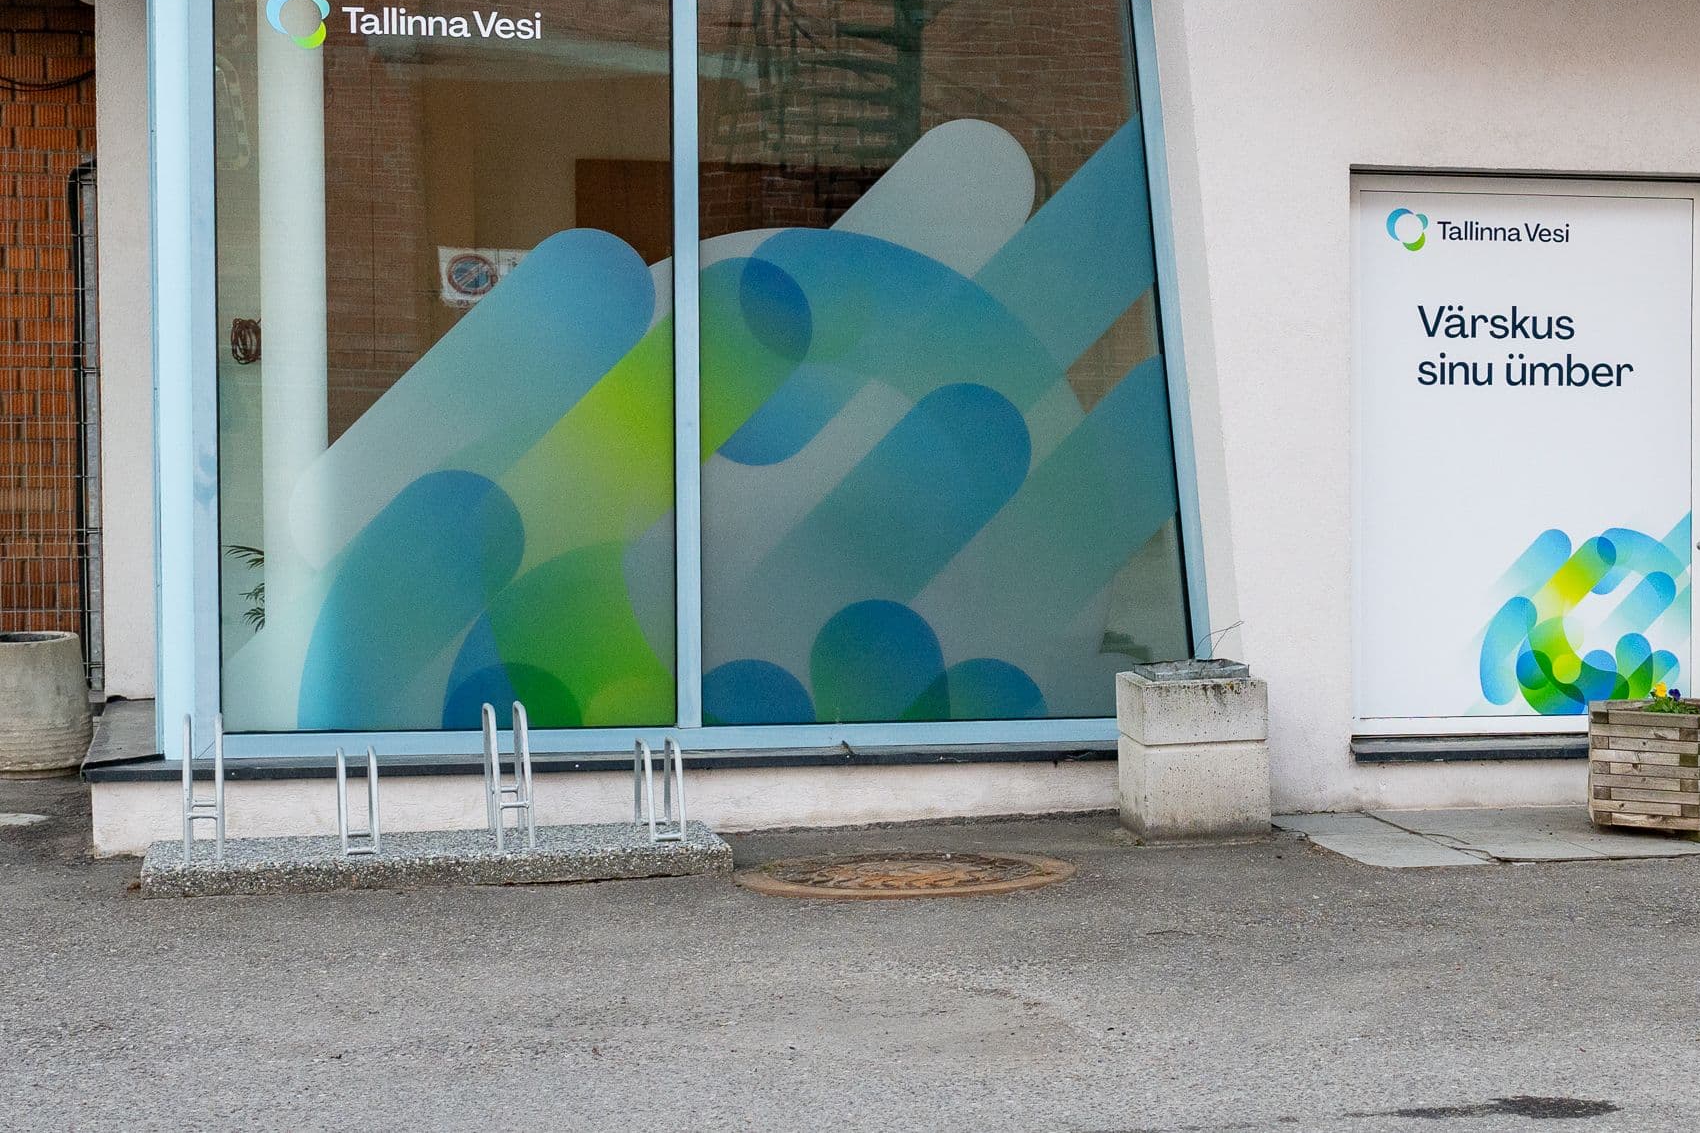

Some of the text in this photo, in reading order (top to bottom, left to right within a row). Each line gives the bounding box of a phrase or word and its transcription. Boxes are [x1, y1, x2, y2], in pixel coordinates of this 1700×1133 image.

[341, 6, 542, 40] Tallinna Vesi
[1437, 220, 1570, 243] Tallinna Vesi
[1417, 304, 1576, 341] Värskus
[1417, 351, 1635, 388] sinu ümber
